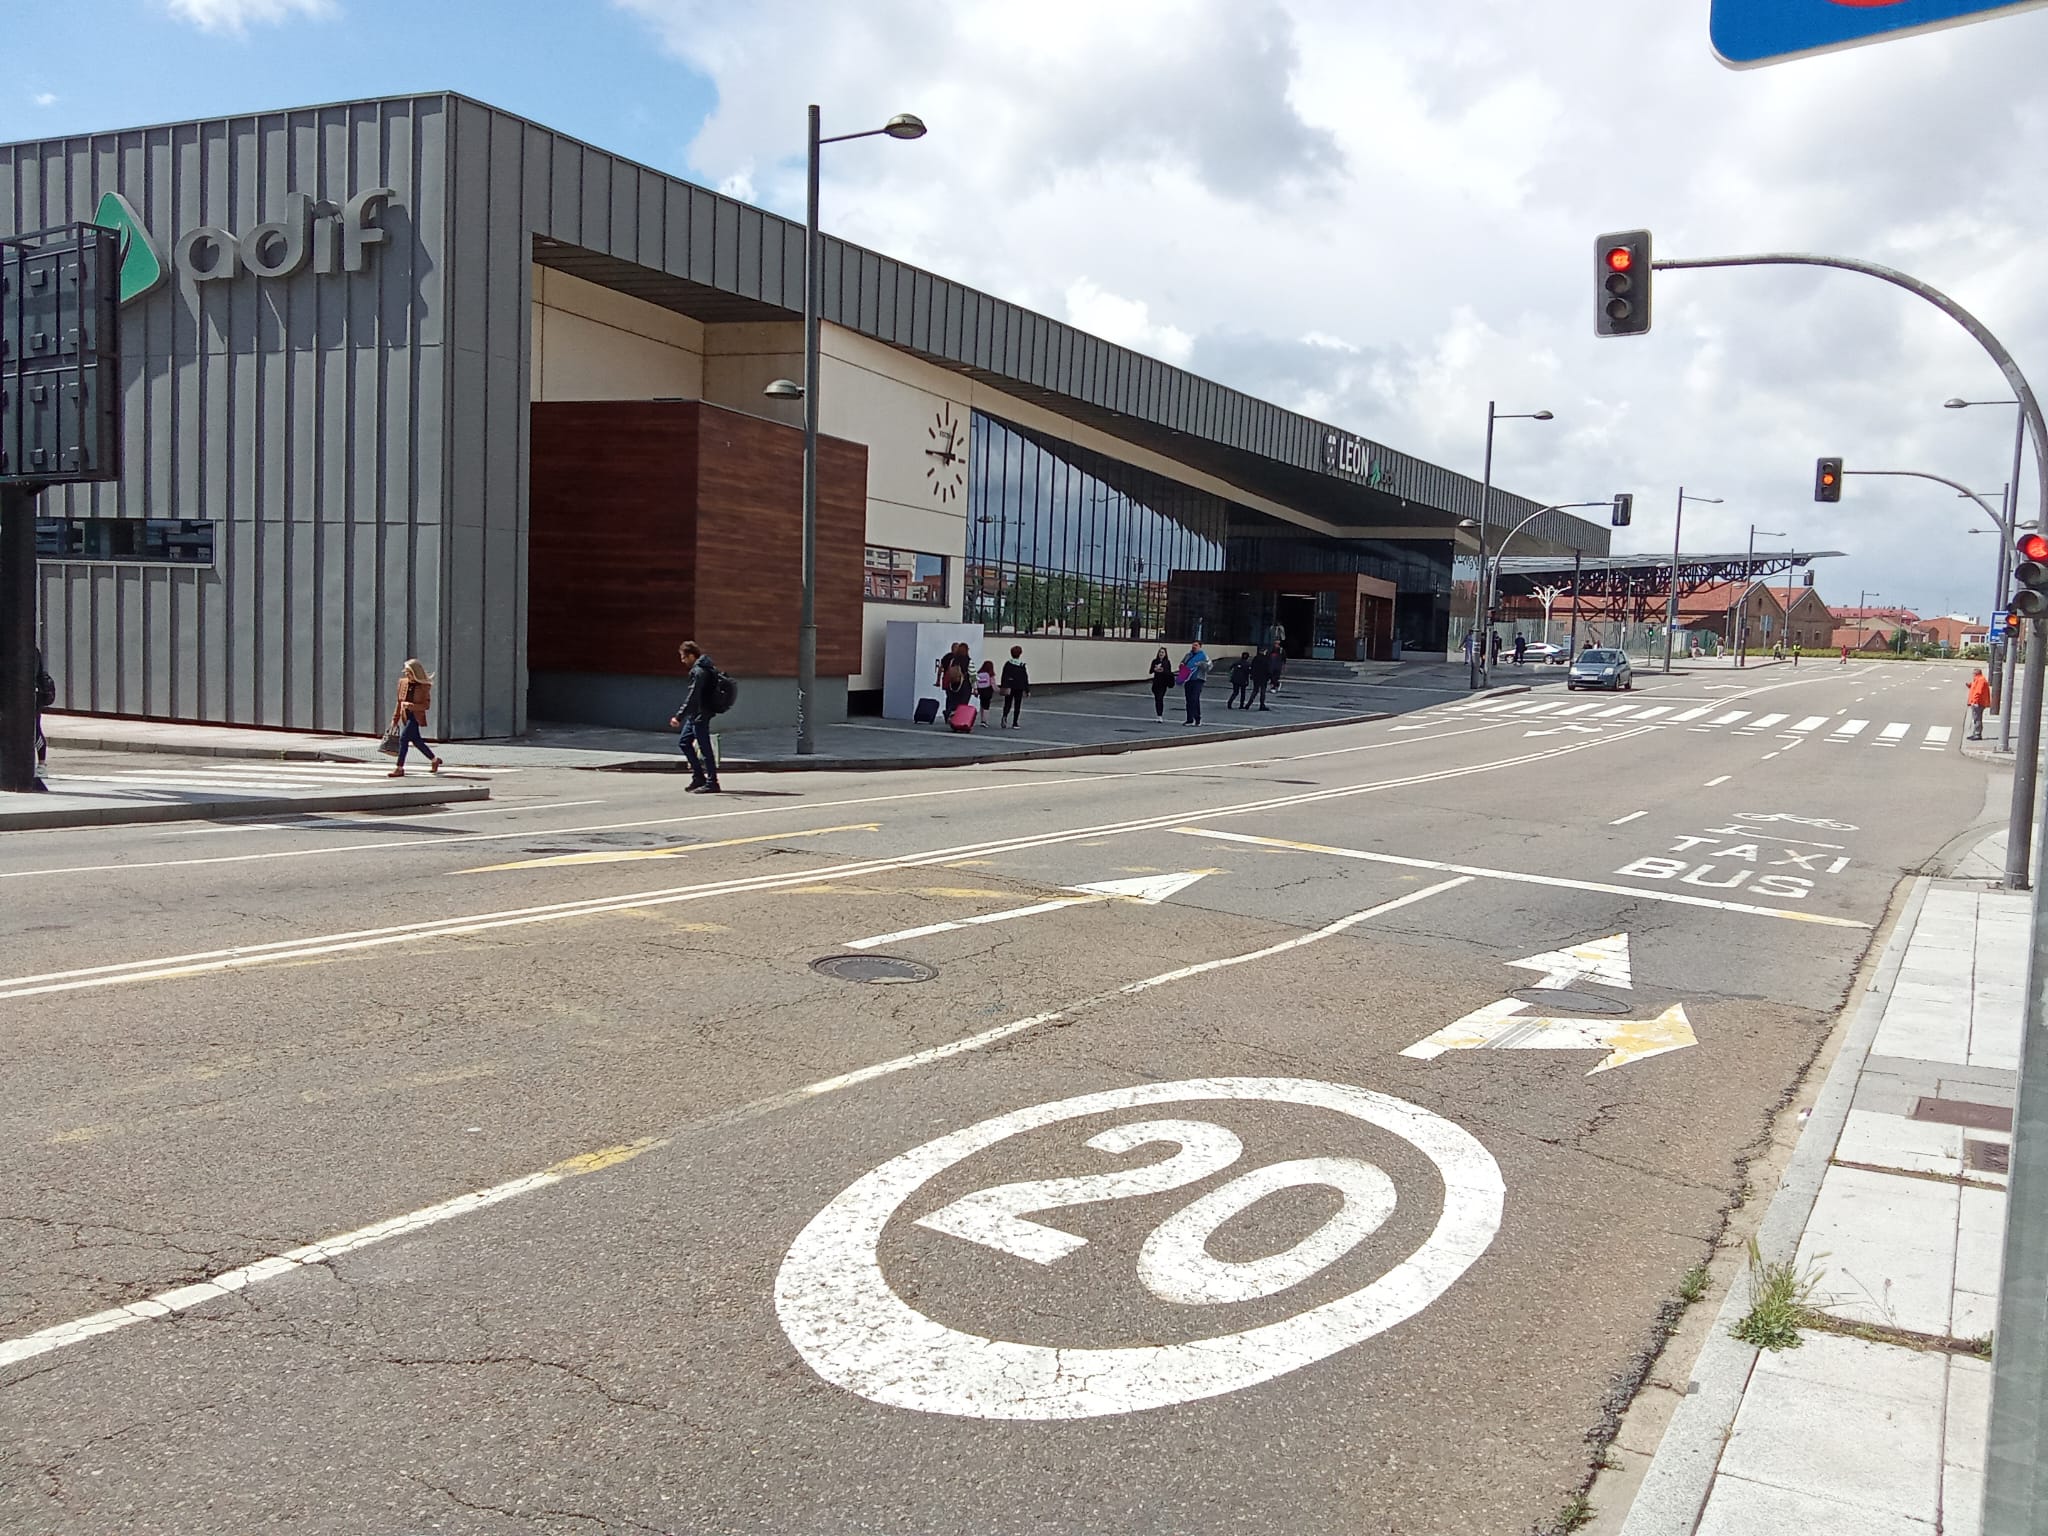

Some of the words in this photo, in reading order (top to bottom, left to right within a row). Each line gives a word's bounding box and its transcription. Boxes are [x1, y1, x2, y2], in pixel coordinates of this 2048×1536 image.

[174, 187, 397, 281] adif
[1339, 436, 1370, 478] LEÓN
[1668, 834, 1851, 874] TAXI
[1613, 856, 1815, 899] BUS
[912, 1118, 1398, 1305] 20
